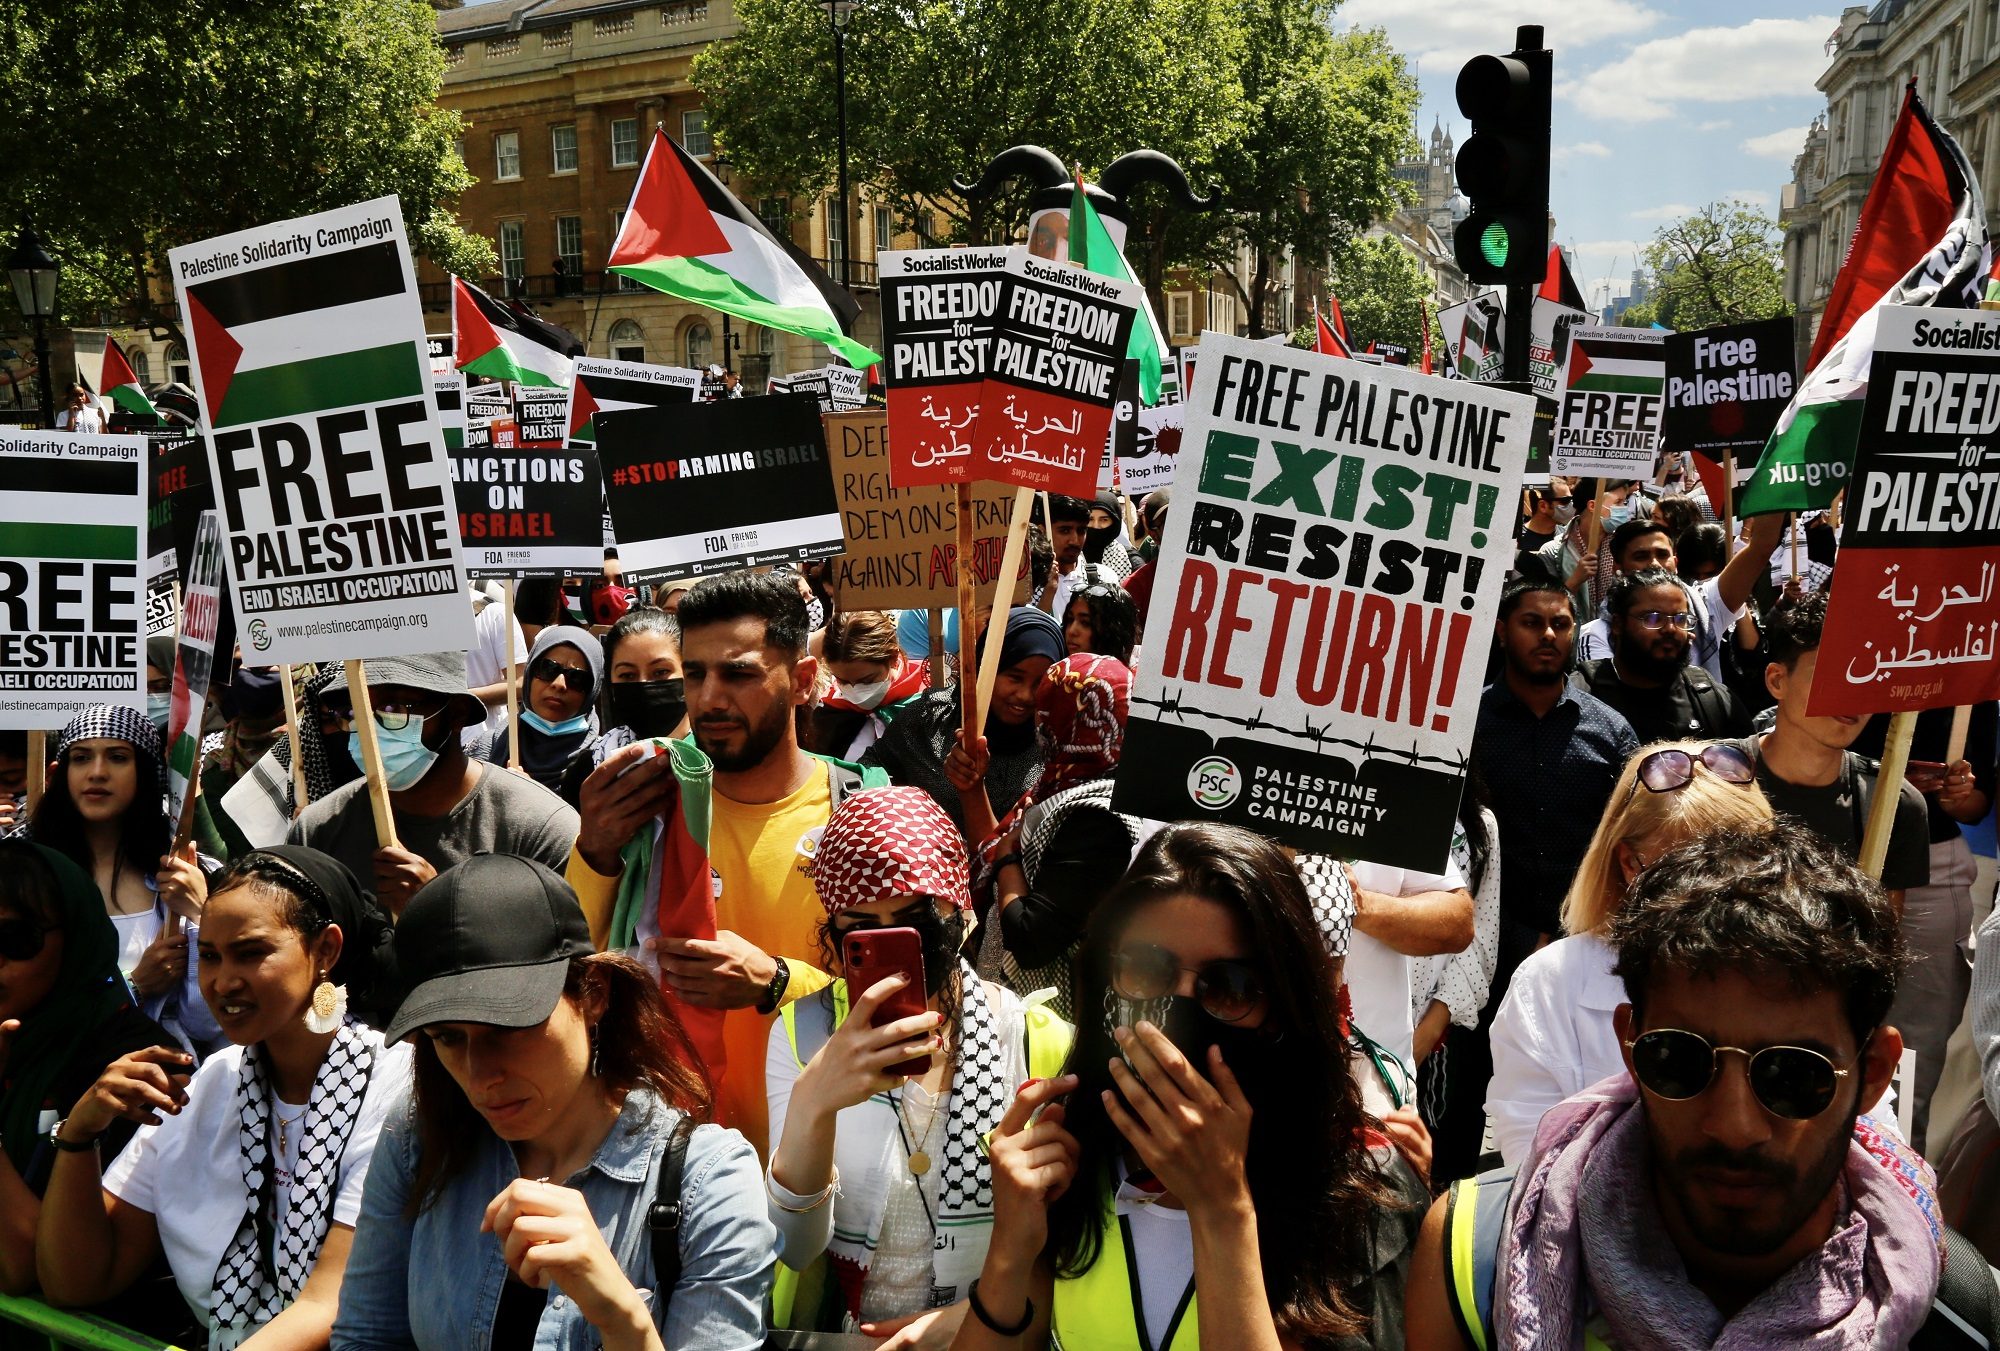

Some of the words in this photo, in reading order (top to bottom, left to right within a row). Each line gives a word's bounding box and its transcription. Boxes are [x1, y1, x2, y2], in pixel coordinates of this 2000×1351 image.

[180, 249, 239, 279] Palestine
[241, 234, 311, 265] Solidarity
[316, 217, 393, 247] Campaign
[897, 280, 1002, 322] FREEDO
[1008, 284, 1120, 346] FREEDOM
[953, 320, 973, 337] for
[1052, 331, 1071, 351] for
[1574, 330, 1603, 338] Palestine
[1605, 332, 1636, 340] Solidarity
[894, 337, 991, 379] PALEST
[993, 338, 1115, 399] PALESTINE
[1694, 337, 1757, 370] Free
[577, 363, 612, 375] Palestine
[614, 367, 652, 380] Solidarity
[654, 371, 696, 386] Campaign
[843, 372, 861, 384] NOT
[1669, 368, 1793, 408] Palestine
[1002, 394, 1083, 435] الحرية
[1212, 354, 1313, 432] FREE
[1314, 374, 1511, 473] PALESTINE
[1561, 392, 1661, 432] FREE
[522, 424, 563, 440] PALESTI
[1559, 428, 1654, 450] PALESTINE
[69, 442, 138, 460] Campaign
[213, 400, 444, 532] FREE
[613, 444, 819, 486] #STOPARMINGISRAEL
[987, 433, 1086, 472] لفلسطين
[1558, 448, 1574, 456] END
[1575, 449, 1603, 457] ISRAELI
[1605, 450, 1652, 460] OCCUPATION
[1958, 438, 1986, 467] for
[1011, 466, 1050, 483] swp.org.uk
[1125, 468, 1150, 478] Stop
[1153, 464, 1171, 474] the
[488, 485, 524, 510] ON
[1198, 429, 1499, 549] EXIST!
[458, 513, 555, 537] ISRAEL
[230, 511, 452, 581] PALESTINE
[484, 552, 503, 564] FOA
[704, 535, 728, 554] FOA
[731, 531, 758, 542] FRIENDS
[1186, 501, 1485, 611] RESIST!
[838, 552, 922, 590] AGAINST
[242, 589, 273, 610] END
[277, 582, 340, 607] ISRAELI
[343, 569, 455, 598] OCCUPATION
[1877, 560, 1996, 622] الحرية
[252, 627, 268, 642] PSC
[277, 612, 428, 638] www.palestinecampaign.org
[1161, 558, 1473, 732] RETURN!
[1846, 619, 1999, 684] لفلسطين
[34, 674, 135, 689] OCCUPATION
[1889, 678, 1944, 700] swp.org.uk
[1198, 773, 1230, 794] PSC
[1255, 766, 1377, 802] PALESTINE
[1248, 802, 1366, 836] CAMPAIGN
[1251, 784, 1387, 821] SOLIDARITY
